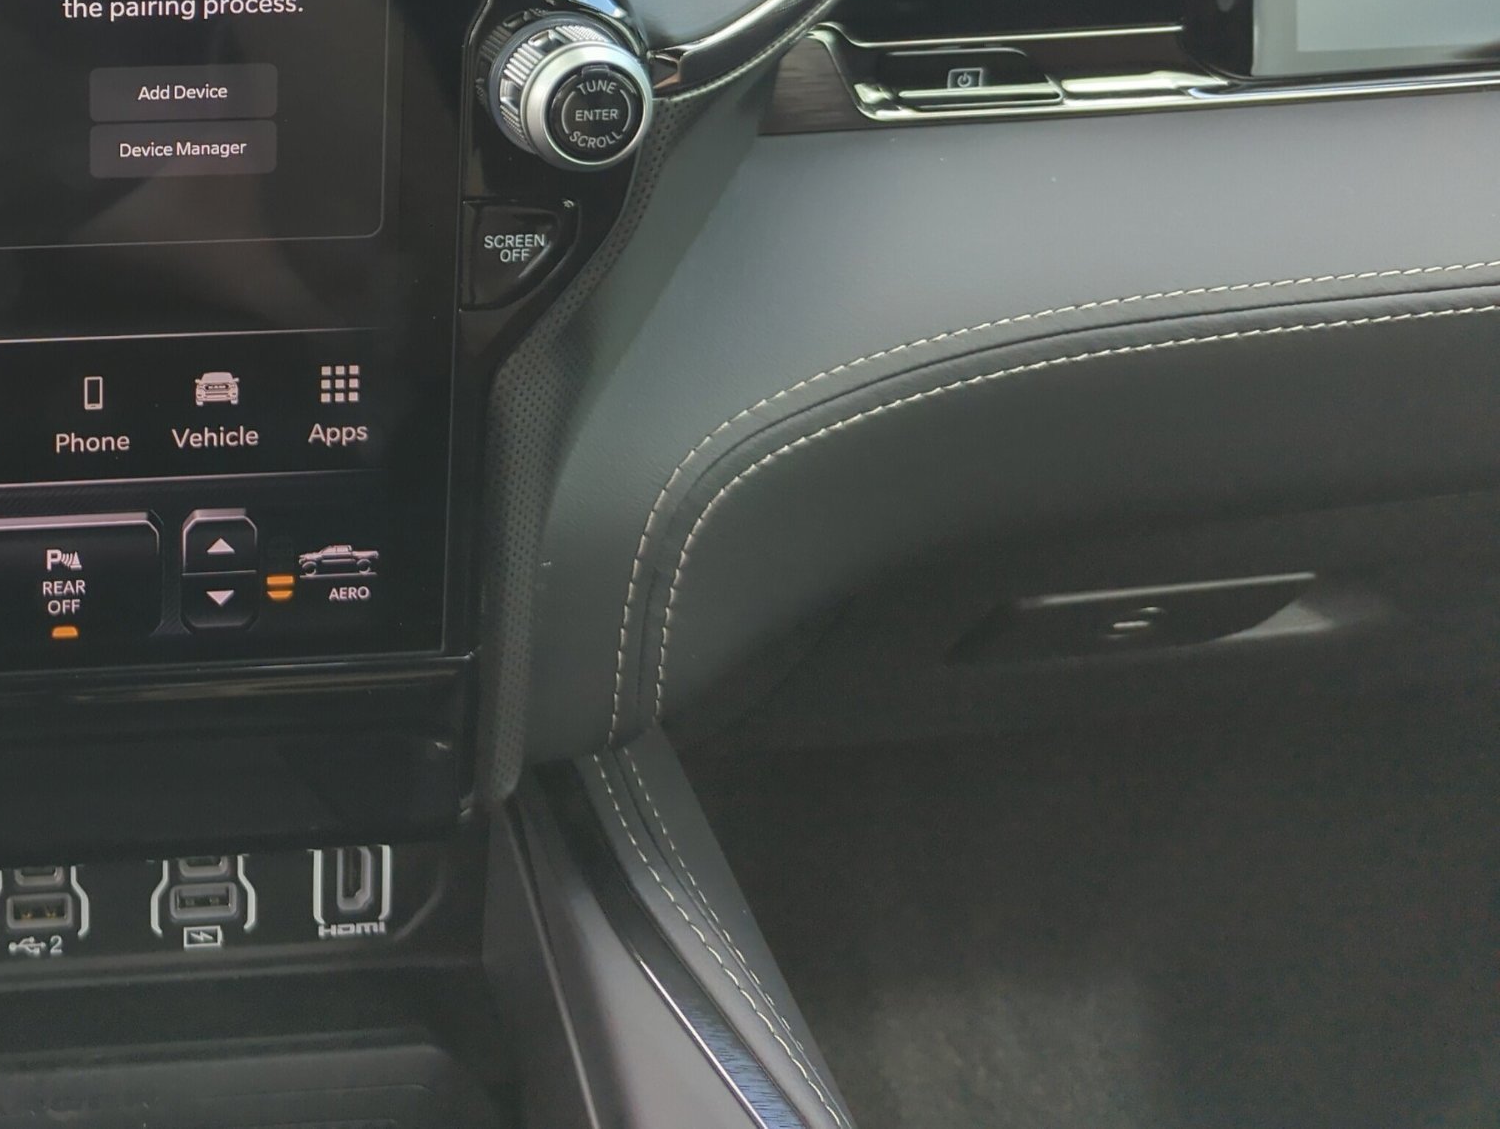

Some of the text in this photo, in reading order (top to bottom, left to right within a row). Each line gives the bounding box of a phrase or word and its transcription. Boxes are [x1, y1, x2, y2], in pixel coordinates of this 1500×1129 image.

[137, 83, 228, 101] Add Device
[576, 79, 618, 96] TUNE
[575, 108, 619, 122] ENTER
[568, 129, 623, 149] SCROLL
[118, 141, 247, 161] Device Manager
[483, 234, 545, 249] SCREEN
[500, 248, 530, 263] OFF
[55, 431, 131, 454] Phone
[171, 426, 260, 449] Vehicle
[307, 422, 369, 447] Apps
[42, 578, 86, 596] REAR
[328, 585, 373, 603] AERO
[47, 598, 81, 616] OFF
[317, 921, 388, 939] HDMI
[50, 934, 63, 954] 2
